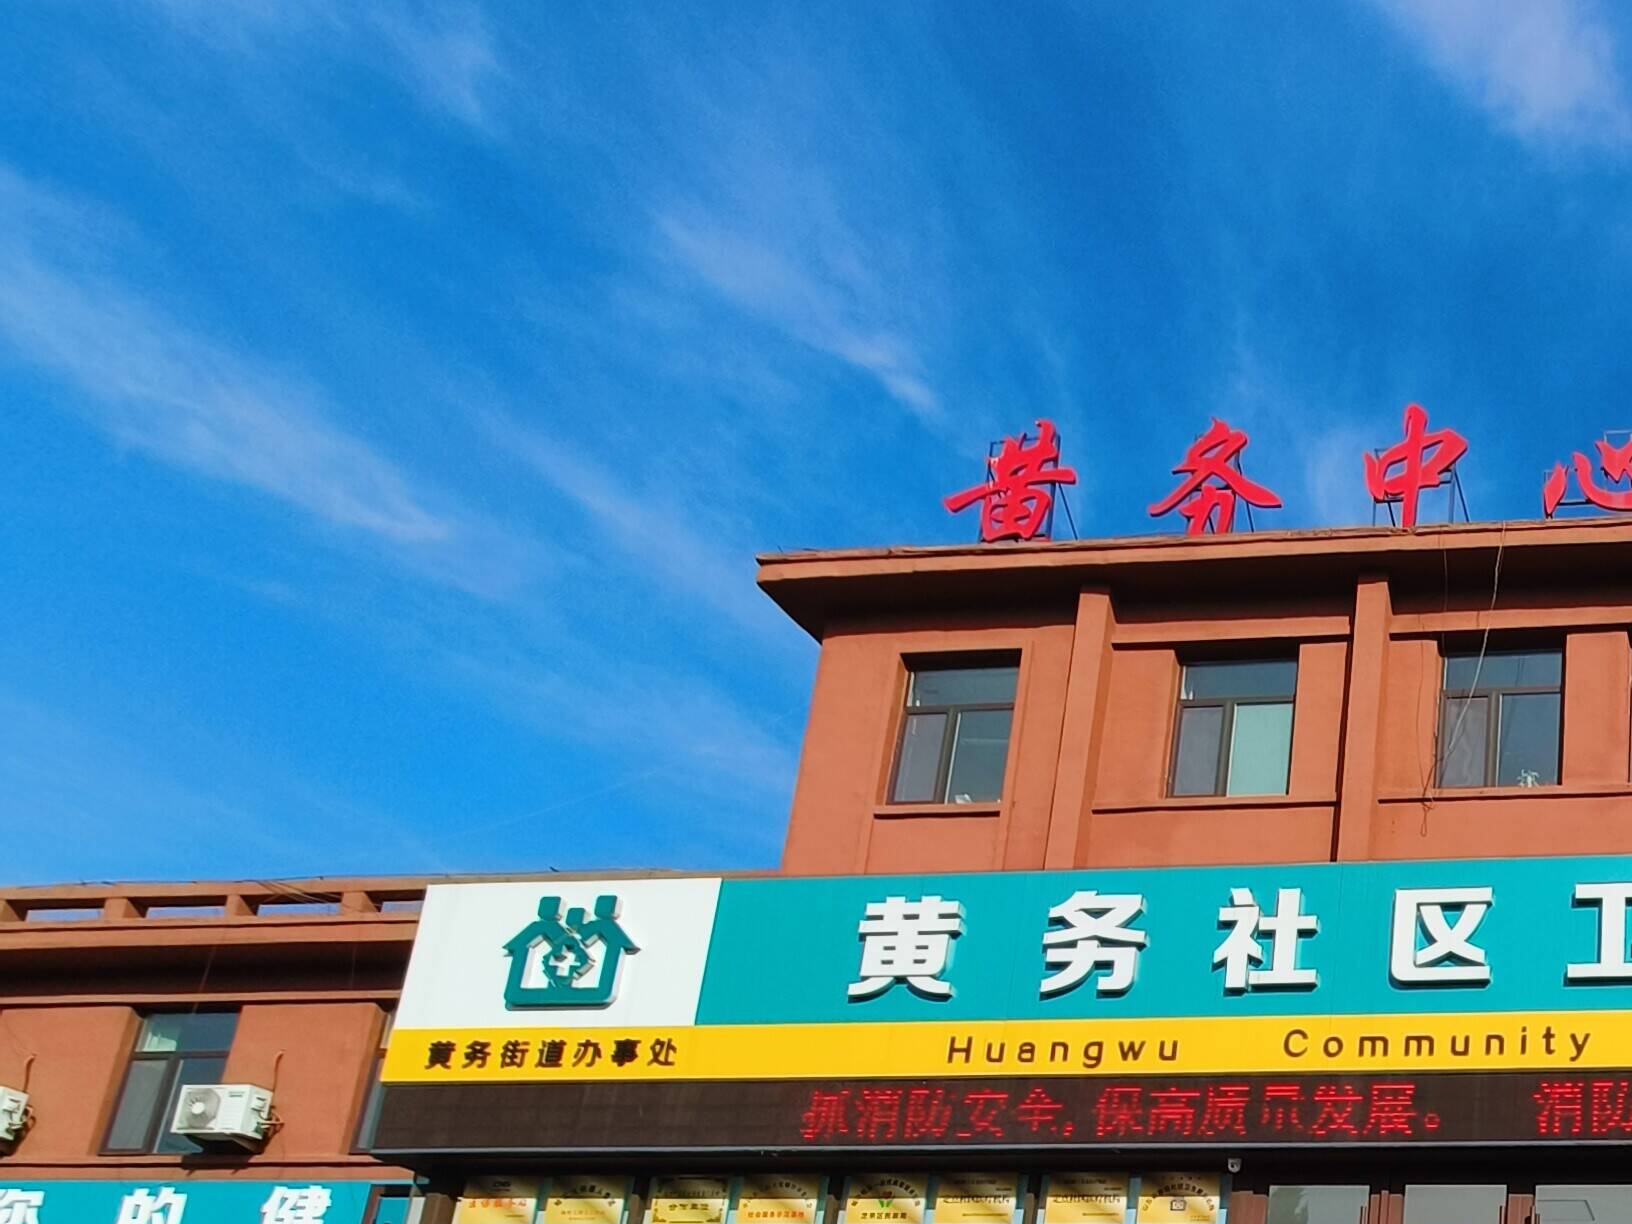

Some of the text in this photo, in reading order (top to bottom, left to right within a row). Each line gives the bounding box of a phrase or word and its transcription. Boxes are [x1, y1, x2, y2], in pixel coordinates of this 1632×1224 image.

[424, 1038, 678, 1070] 黄务街道办事处
[946, 1036, 1181, 1070] Huangwu
[1283, 1027, 1592, 1061] Community
